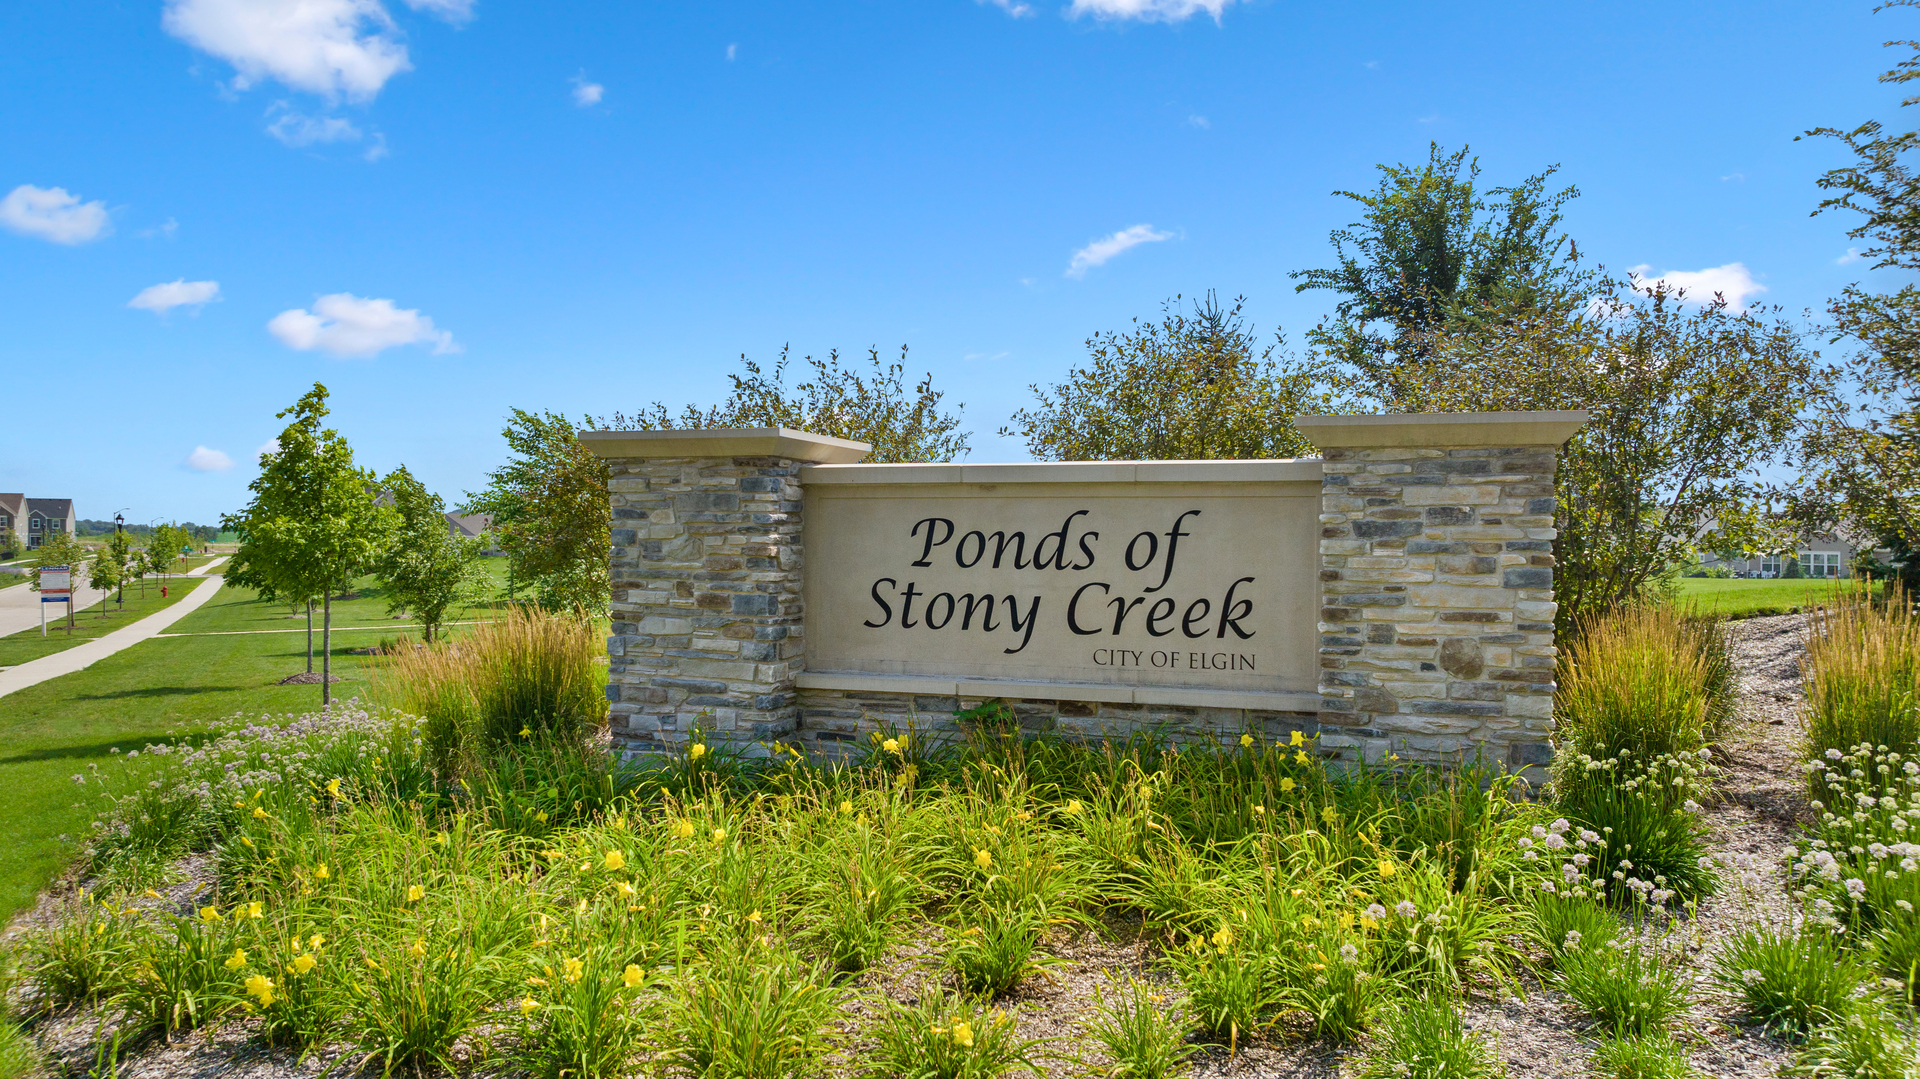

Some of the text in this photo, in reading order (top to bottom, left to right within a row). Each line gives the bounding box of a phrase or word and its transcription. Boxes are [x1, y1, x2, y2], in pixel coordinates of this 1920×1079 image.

[911, 510, 1201, 593] Ponds of
[864, 577, 1256, 655] Stony Creek
[1093, 649, 1256, 671] CITY OF ELGIN
